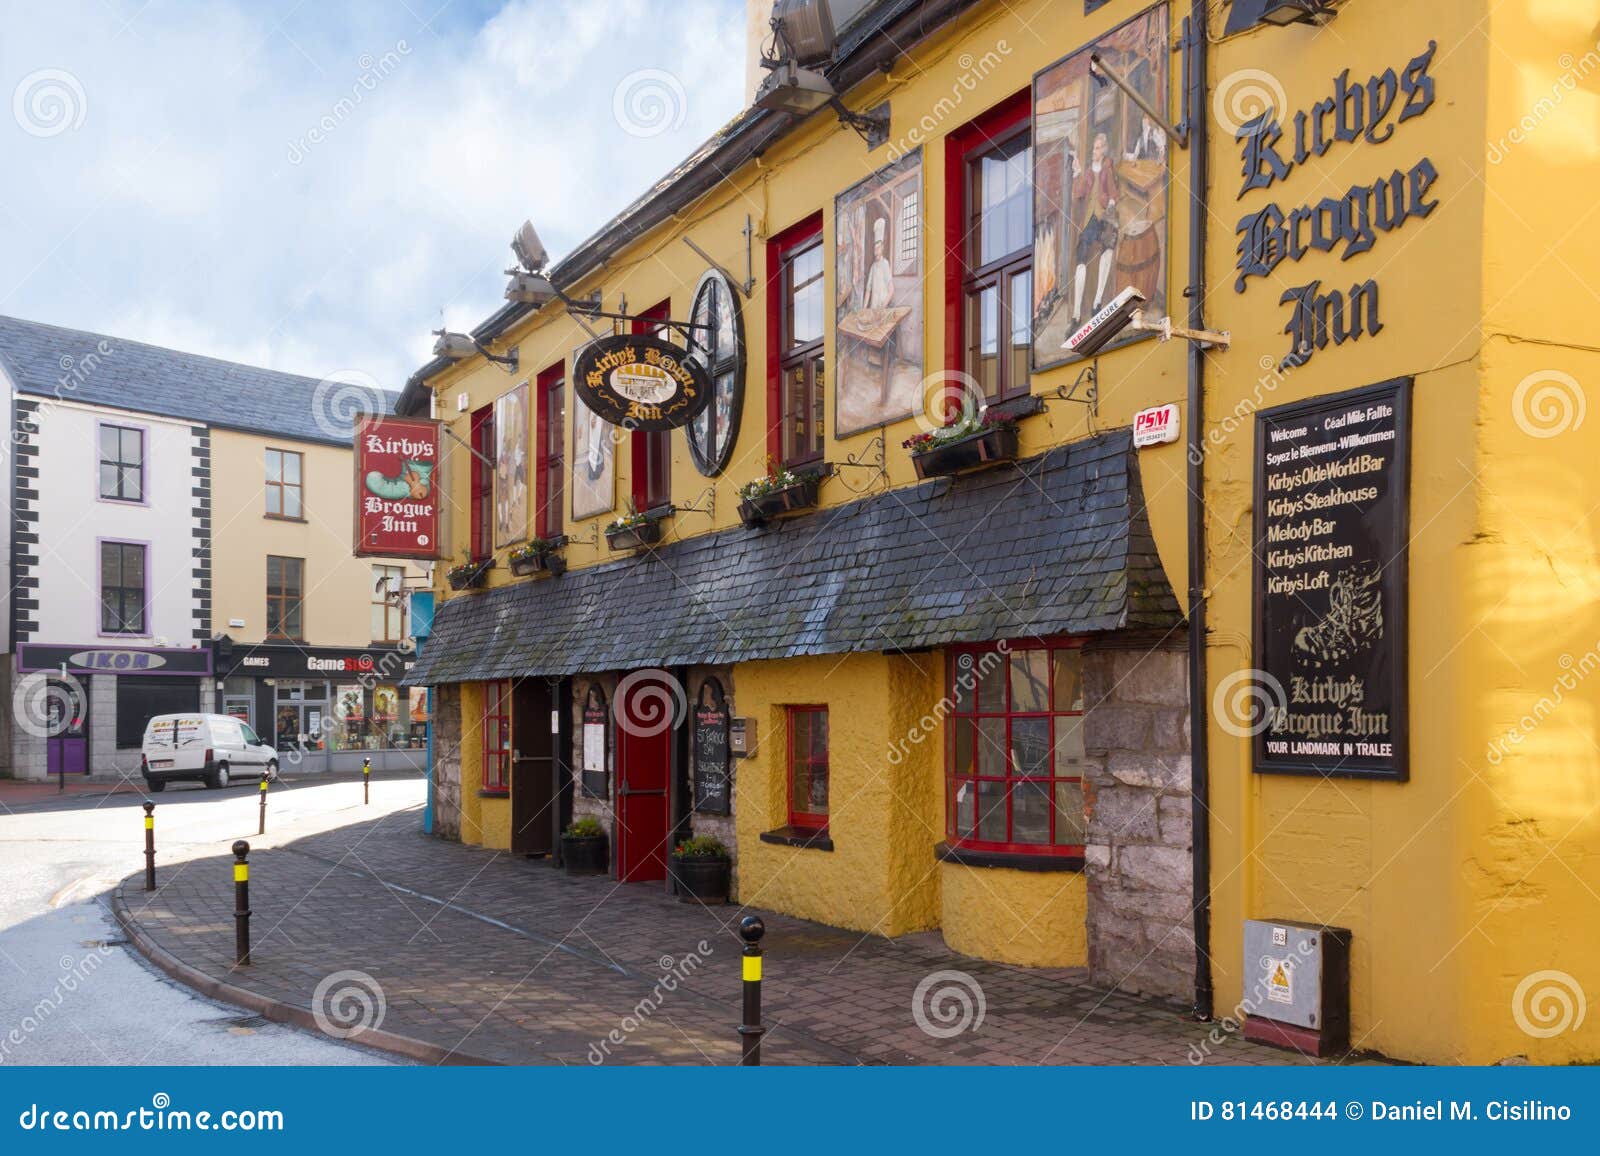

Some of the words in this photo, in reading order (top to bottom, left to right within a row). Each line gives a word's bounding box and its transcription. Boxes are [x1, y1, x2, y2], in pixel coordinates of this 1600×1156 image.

[1234, 157, 1439, 294] Brogue
[1071, 325, 1093, 346] BBM
[1091, 301, 1120, 329] SECURE
[1278, 278, 1385, 373] Inn
[625, 401, 664, 420] Inn
[1136, 409, 1170, 430] PSM
[1271, 425, 1308, 443] Welcome
[365, 434, 434, 461] Kirby's
[1266, 450, 1291, 467] Soyez
[1291, 447, 1299, 460] le
[1300, 441, 1337, 458] Bienvenu
[1301, 464, 1327, 485] Olde
[1325, 456, 1360, 480] World
[1360, 454, 1385, 472] Bar
[365, 496, 433, 518] Brogue
[1303, 485, 1378, 511] Steakhouse
[382, 515, 418, 533] Inn
[1268, 520, 1313, 543] Melody
[1313, 518, 1336, 535] Bar
[1304, 544, 1353, 562] Kitchen
[1304, 571, 1330, 590] Loft
[85, 652, 150, 669] IKON
[243, 656, 270, 667] GAMES
[1290, 674, 1364, 709] Kirby's
[1269, 705, 1342, 740] Brogue
[1346, 705, 1389, 737] Inn
[1267, 741, 1288, 754] YOUR
[1291, 742, 1340, 756] LANDMARK
[1344, 742, 1353, 755] IN
[1356, 742, 1393, 757] TRALEE
